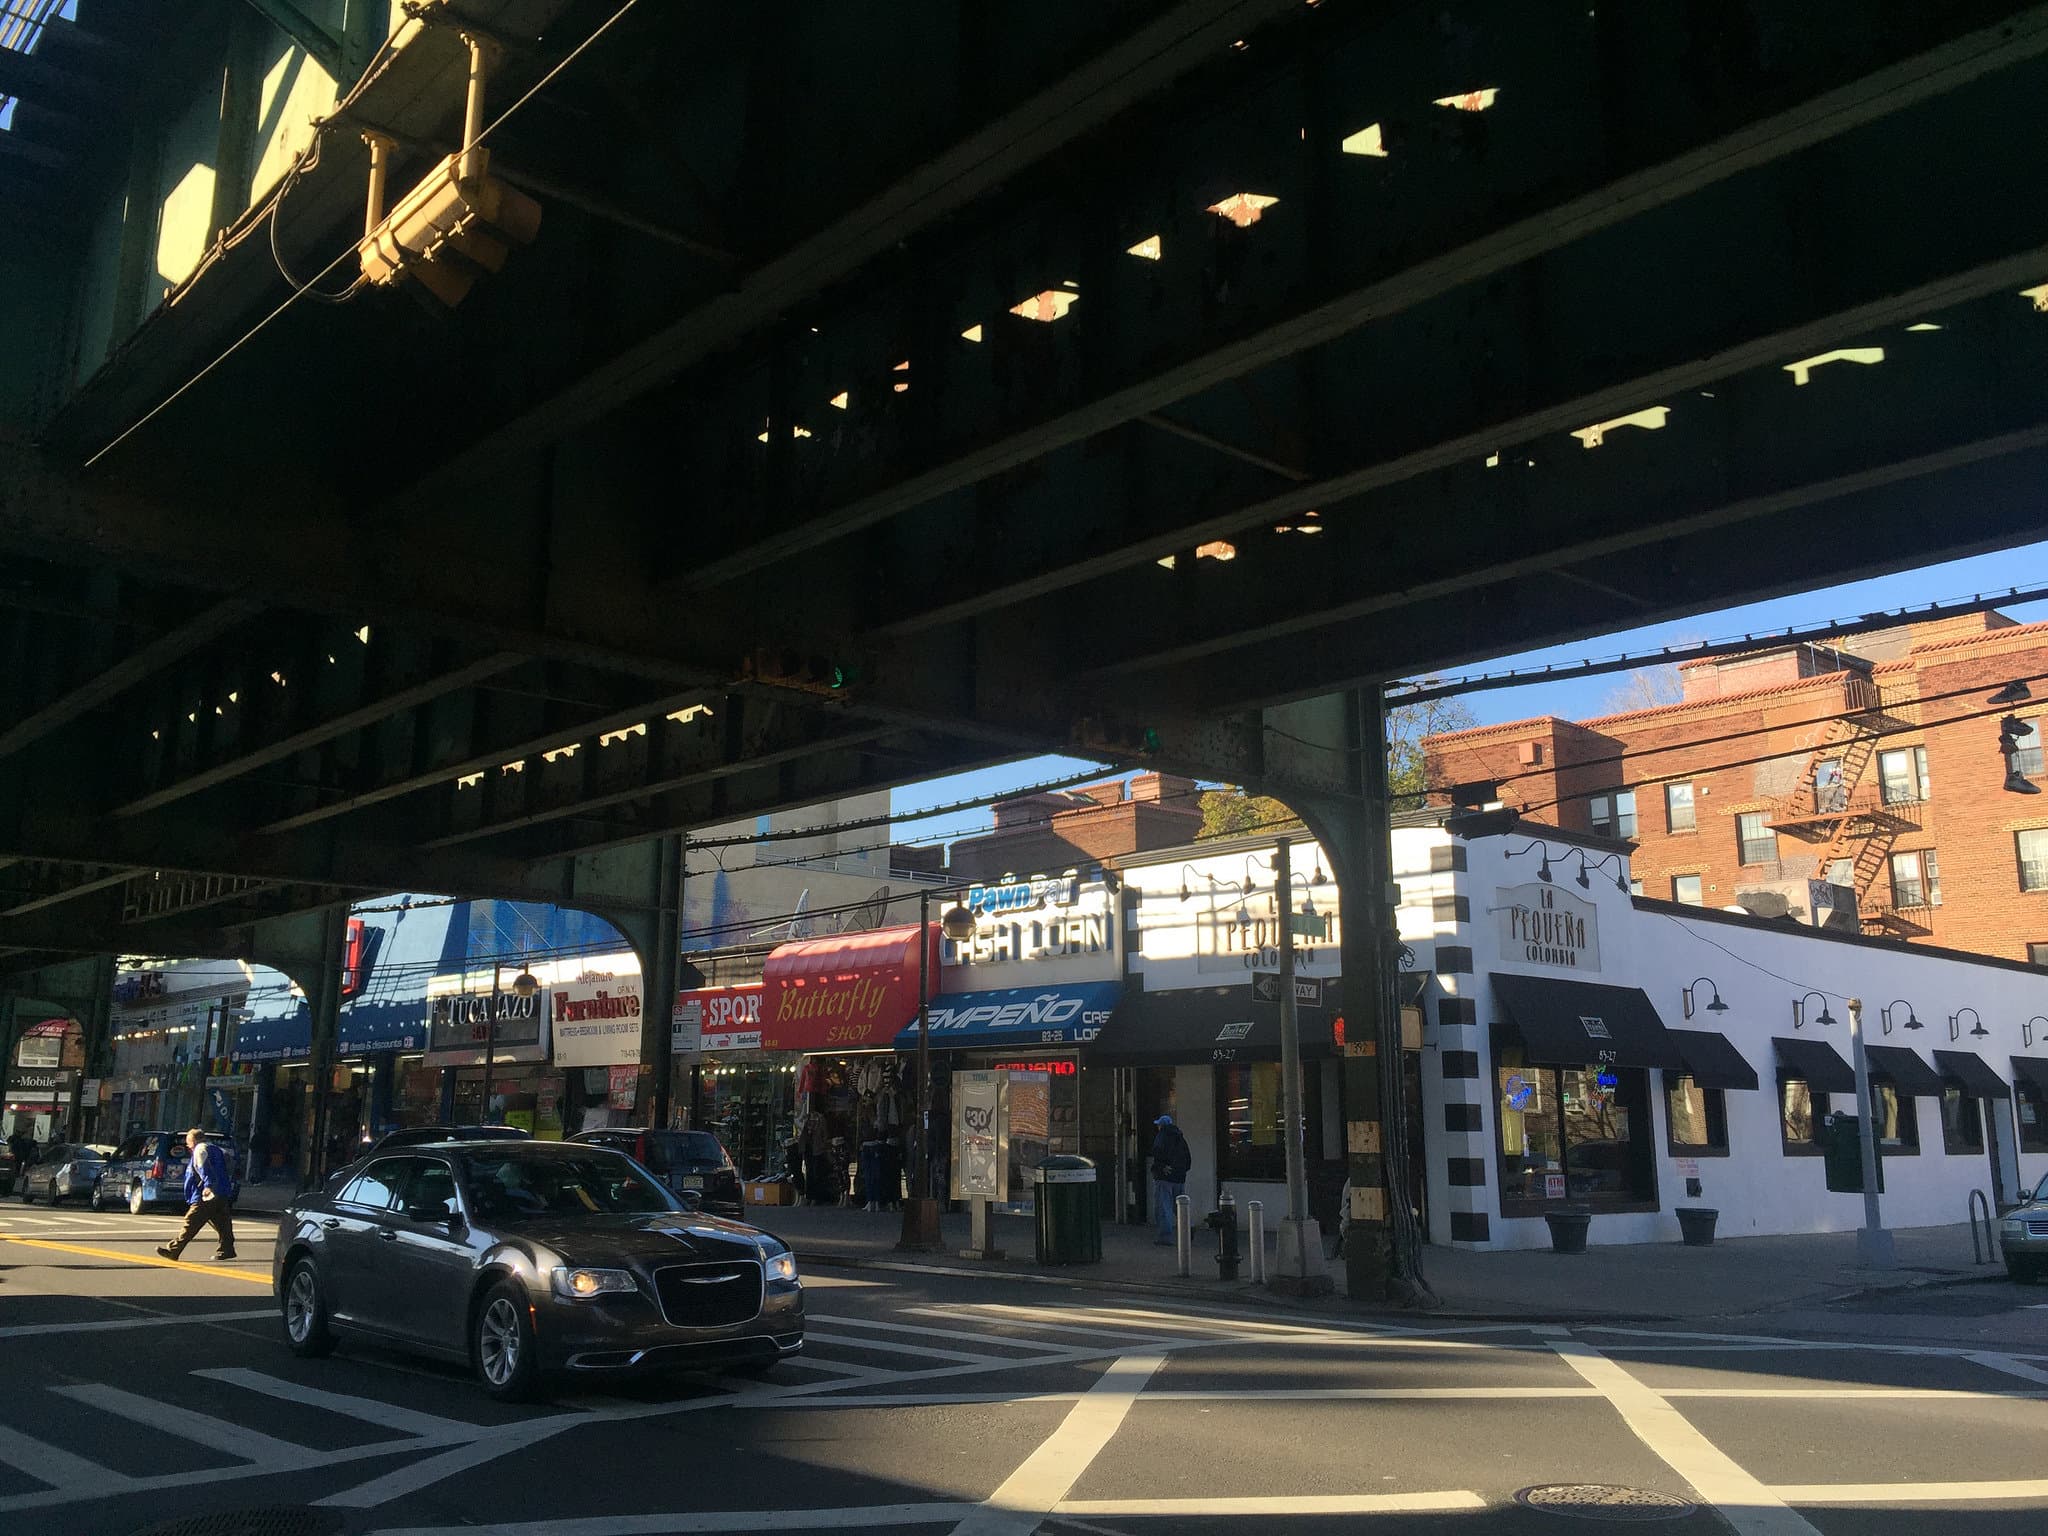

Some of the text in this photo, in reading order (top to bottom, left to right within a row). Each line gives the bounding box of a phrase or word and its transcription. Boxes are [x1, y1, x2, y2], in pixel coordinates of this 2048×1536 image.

[1540, 888, 1553, 909] LA
[1020, 914, 1112, 960] LOAN
[1225, 911, 1333, 952] PEQUA
[1511, 905, 1585, 949] PEQUEÑA
[1243, 947, 1315, 968] COLOIA
[1526, 945, 1576, 966] COLOMBIA
[554, 990, 640, 1022] Furniture
[777, 978, 887, 1021] Butterfly
[907, 993, 1083, 1031] EMPEÑO
[1082, 1011, 1113, 1024] CAS
[827, 1023, 872, 1041] SHOP
[1213, 1049, 1235, 1061] 83-27
[1599, 1050, 1616, 1062] 83-27
[20, 1076, 56, 1087] Mobile
